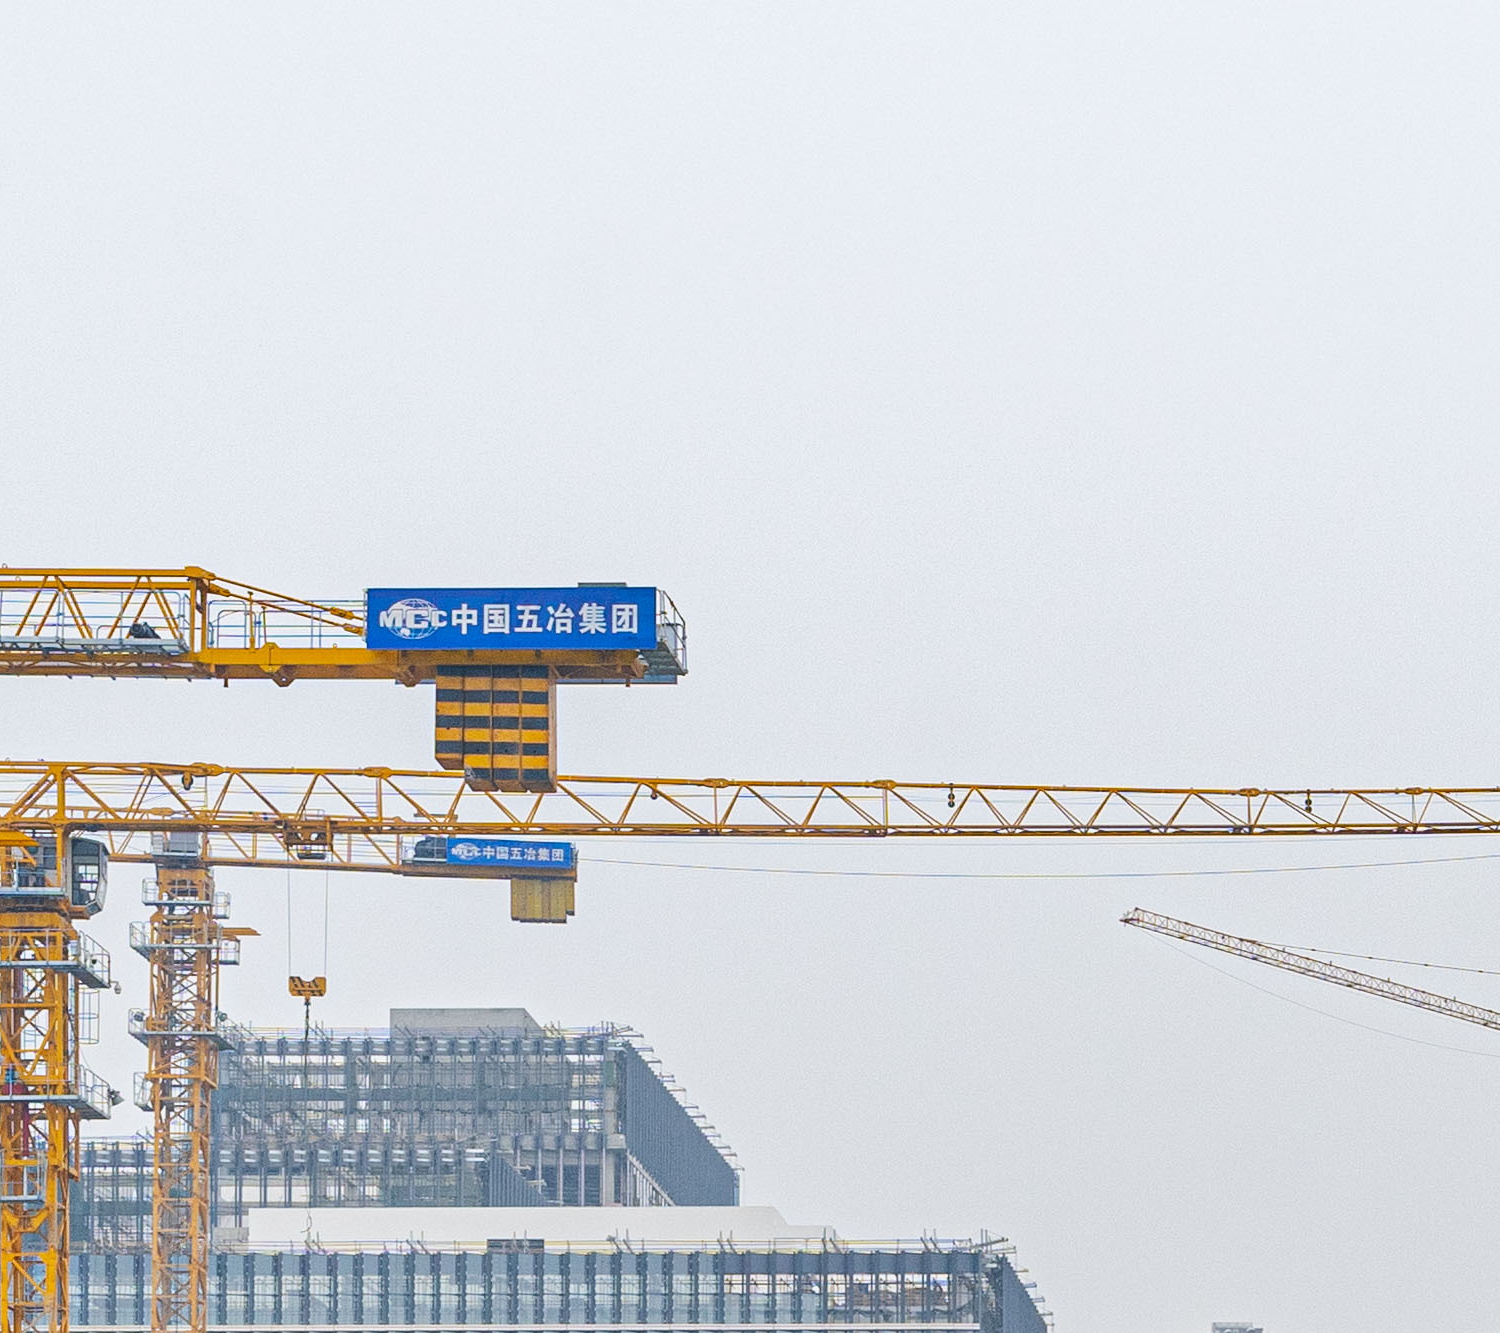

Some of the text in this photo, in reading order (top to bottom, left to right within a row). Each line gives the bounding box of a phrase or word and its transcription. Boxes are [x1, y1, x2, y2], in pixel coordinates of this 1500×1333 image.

[379, 603, 637, 634] MCC 中国五冶集团
[483, 845, 564, 861] 中国五冶集团
